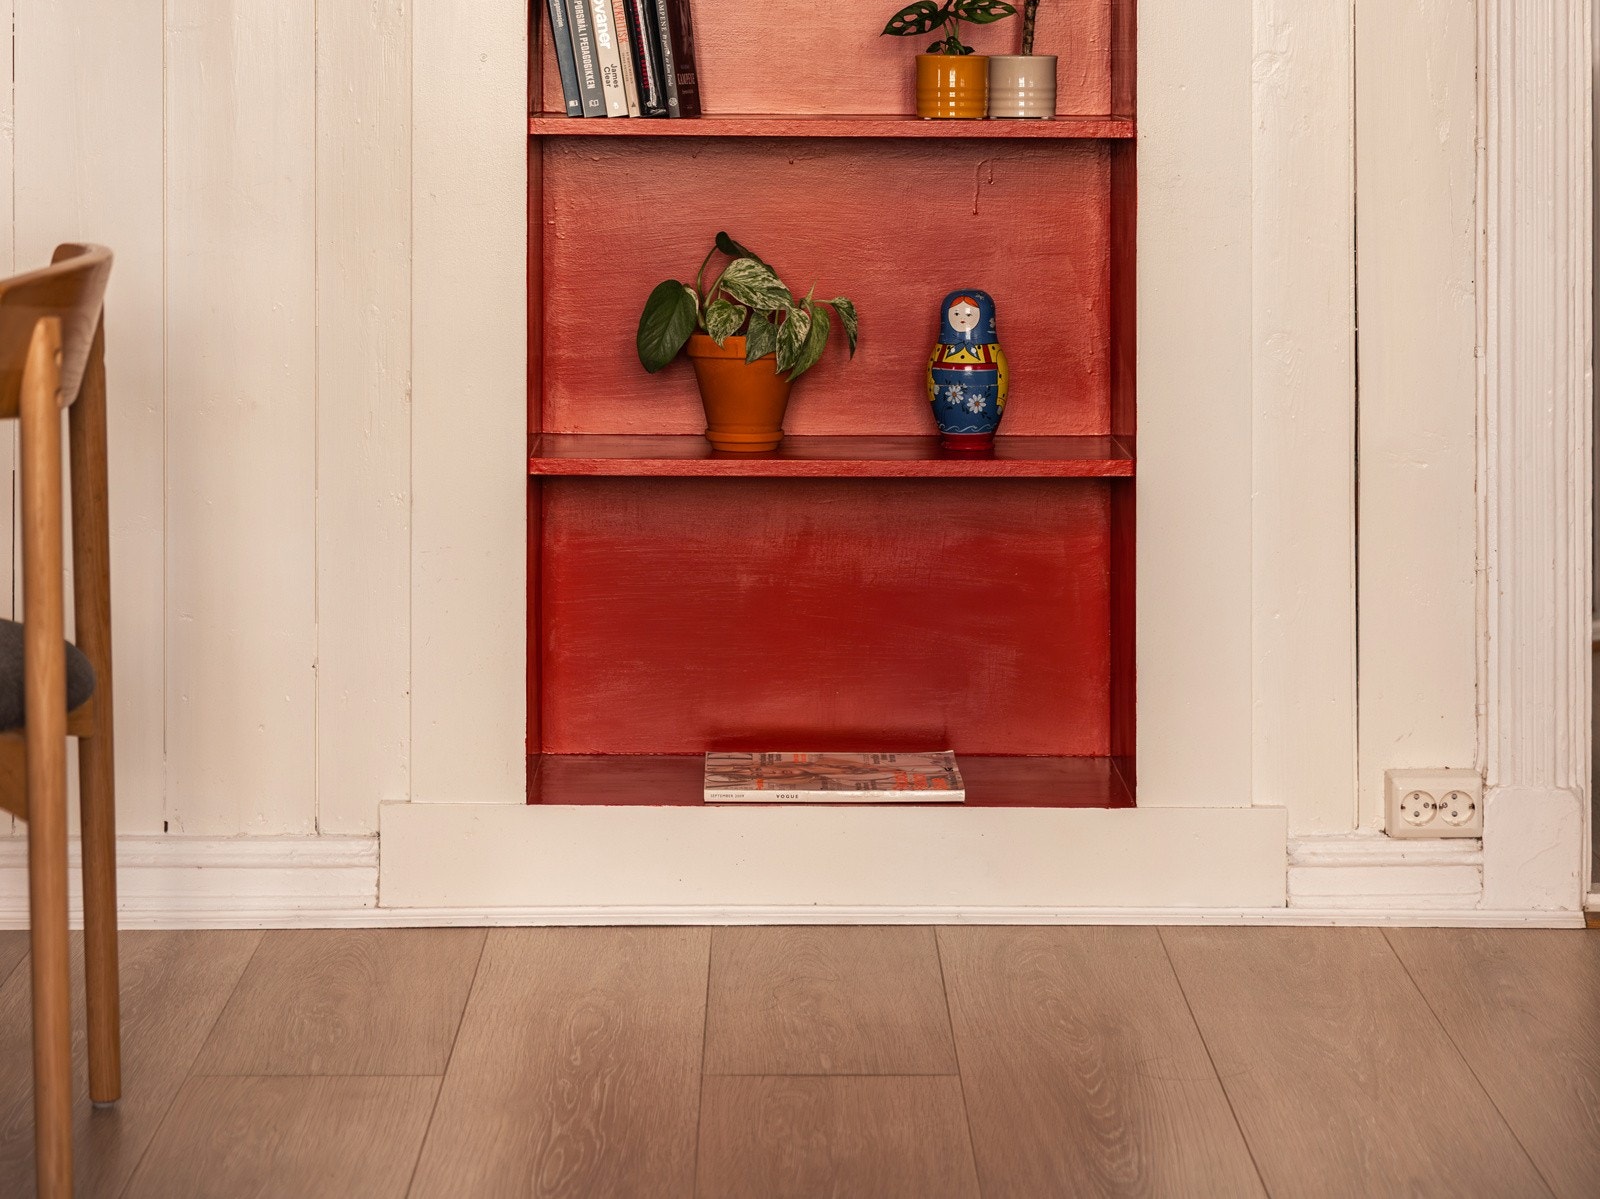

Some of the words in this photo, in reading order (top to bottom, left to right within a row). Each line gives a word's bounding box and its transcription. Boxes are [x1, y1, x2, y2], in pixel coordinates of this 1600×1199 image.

[580, 37, 596, 89] PEDAGOGIKKEN
[610, 63, 619, 89] James
[603, 66, 611, 88] Clear
